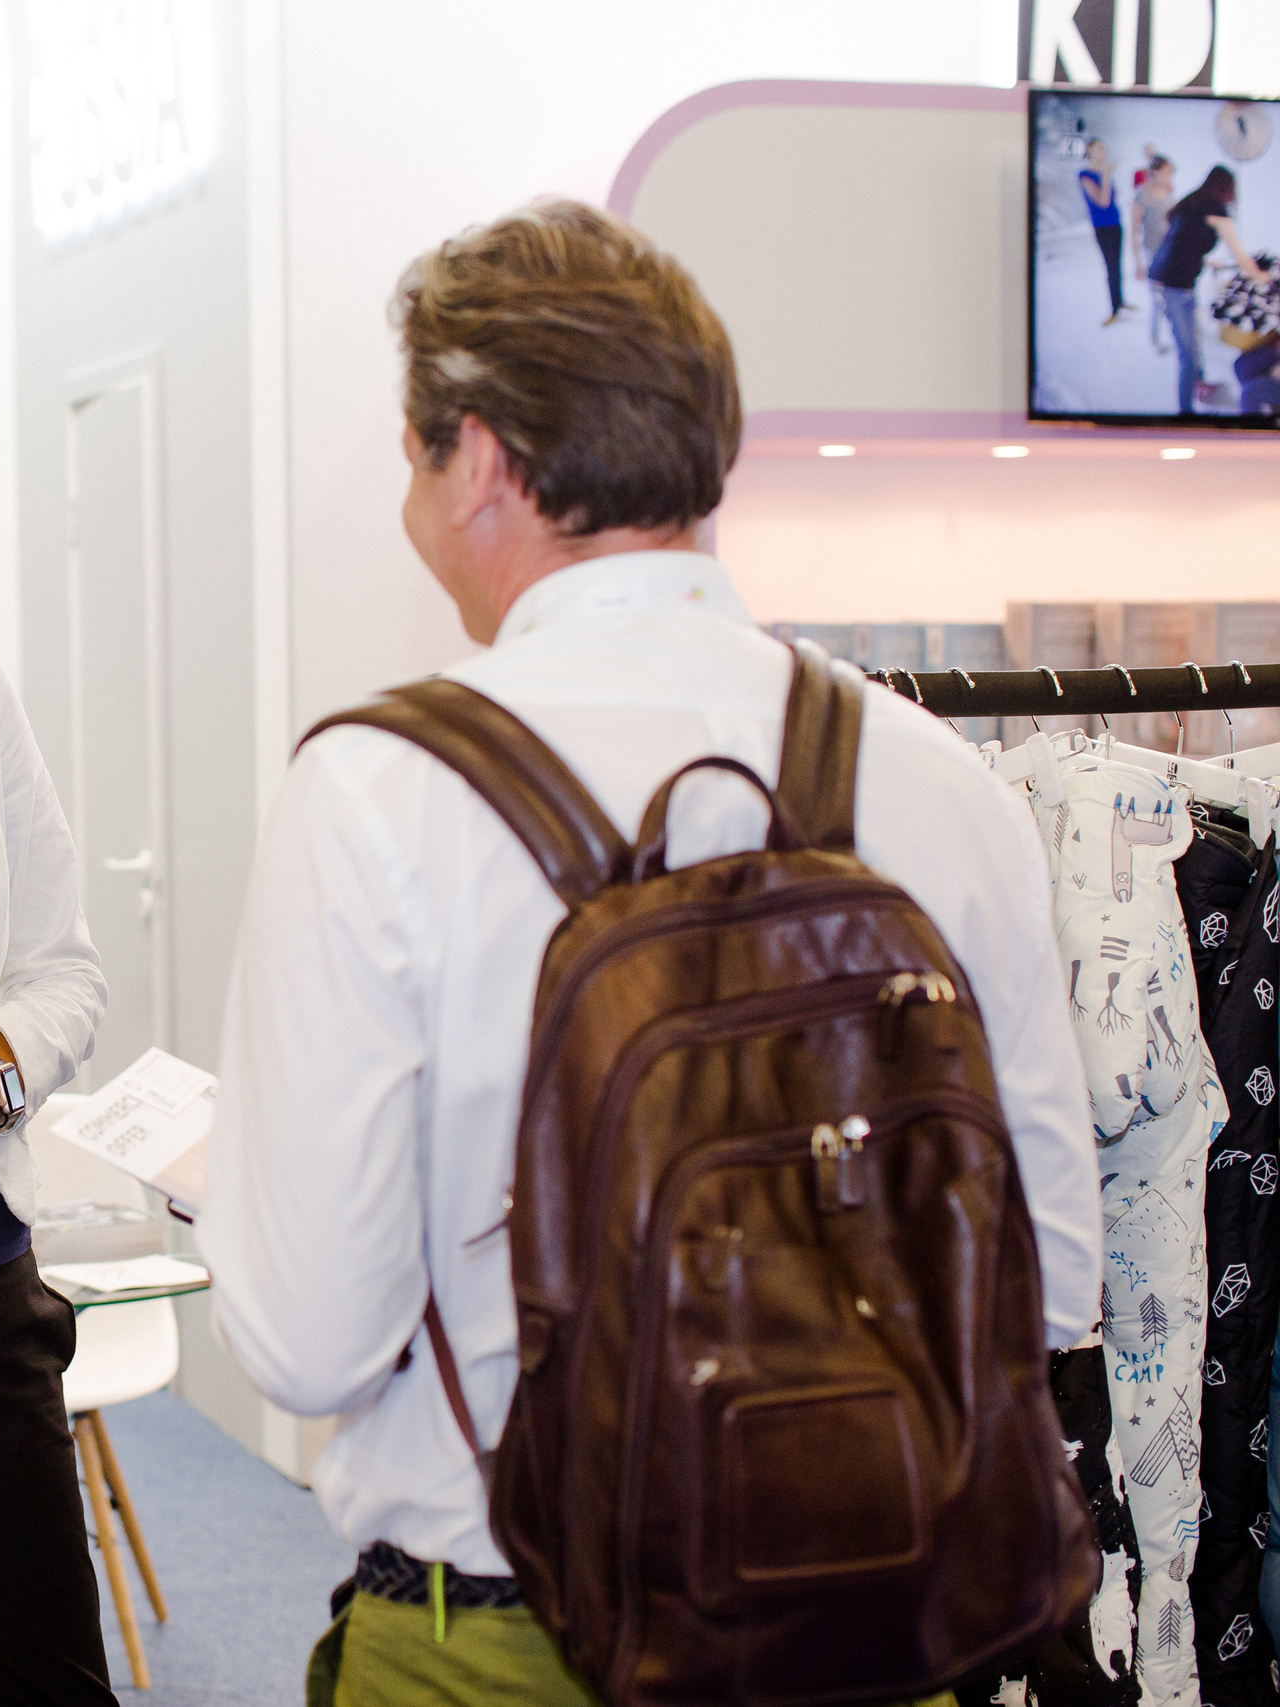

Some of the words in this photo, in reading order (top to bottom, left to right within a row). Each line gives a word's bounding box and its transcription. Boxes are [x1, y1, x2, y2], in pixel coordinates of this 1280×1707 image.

[1029, 0, 1214, 92] KID
[1167, 761, 1179, 774] LEO
[107, 1123, 152, 1156] OFFER
[1115, 1364, 1164, 1384] CAMP
